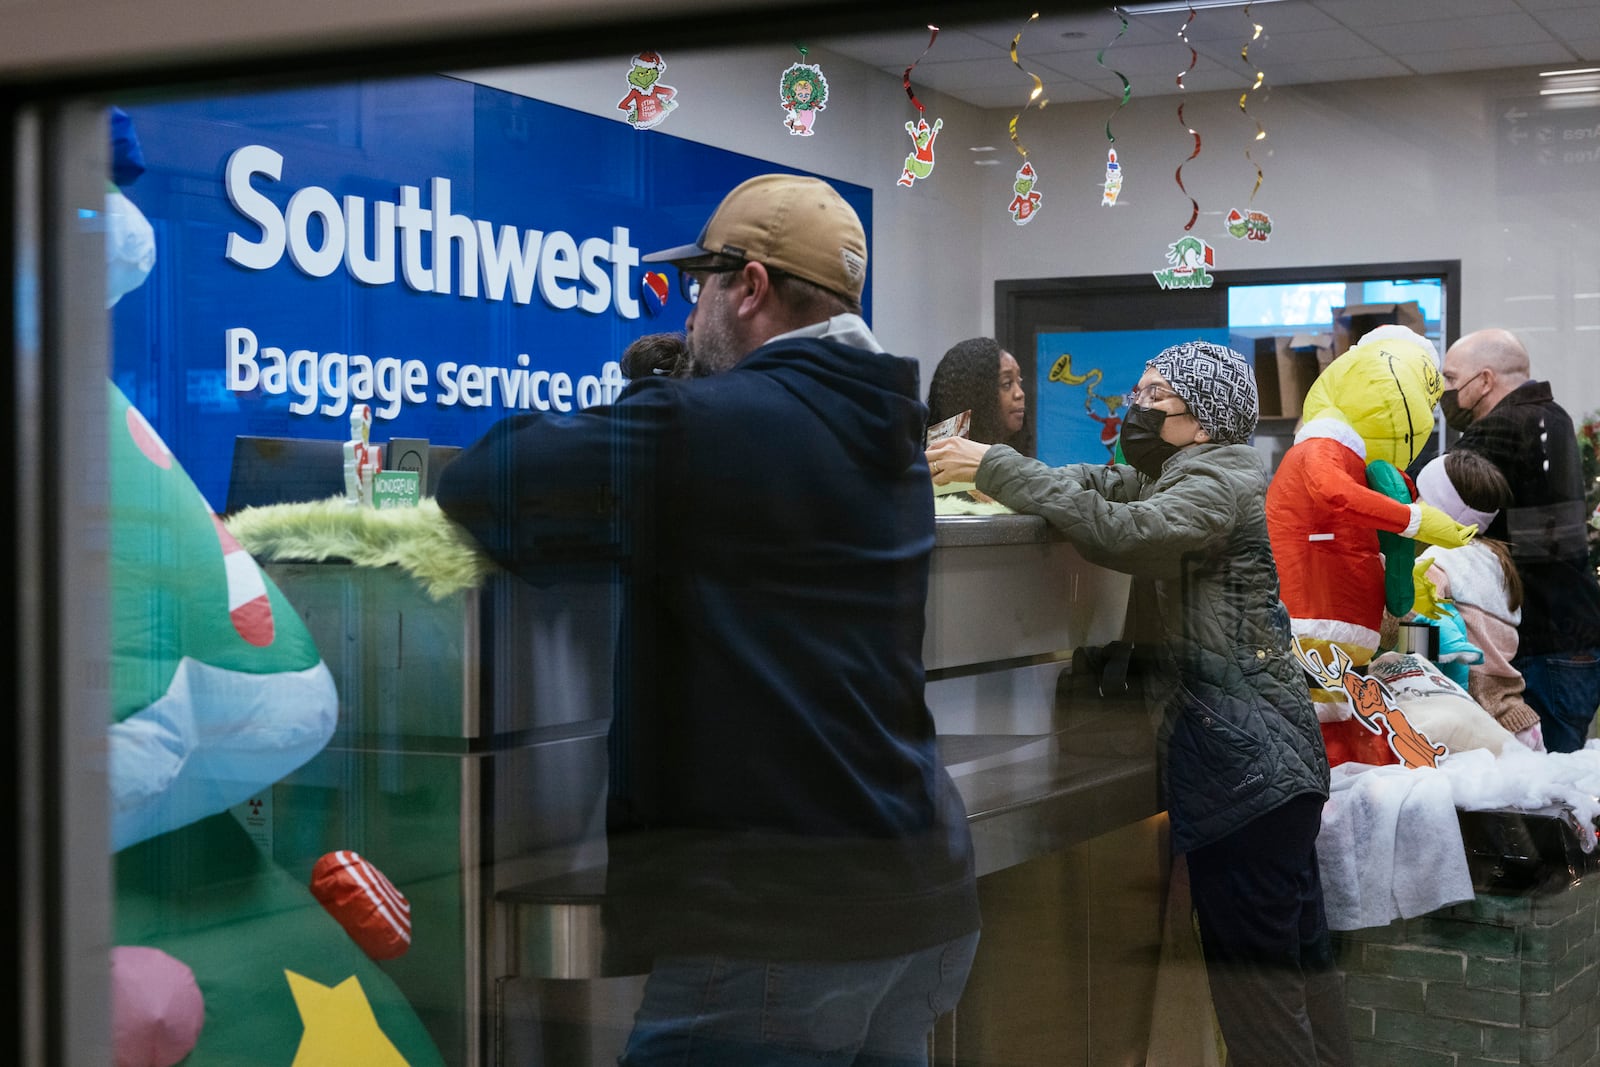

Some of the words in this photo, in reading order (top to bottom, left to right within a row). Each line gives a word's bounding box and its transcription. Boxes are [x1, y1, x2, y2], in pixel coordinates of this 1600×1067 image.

[224, 144, 640, 319] Southwest
[225, 327, 428, 420] Baggage
[436, 354, 573, 413] service
